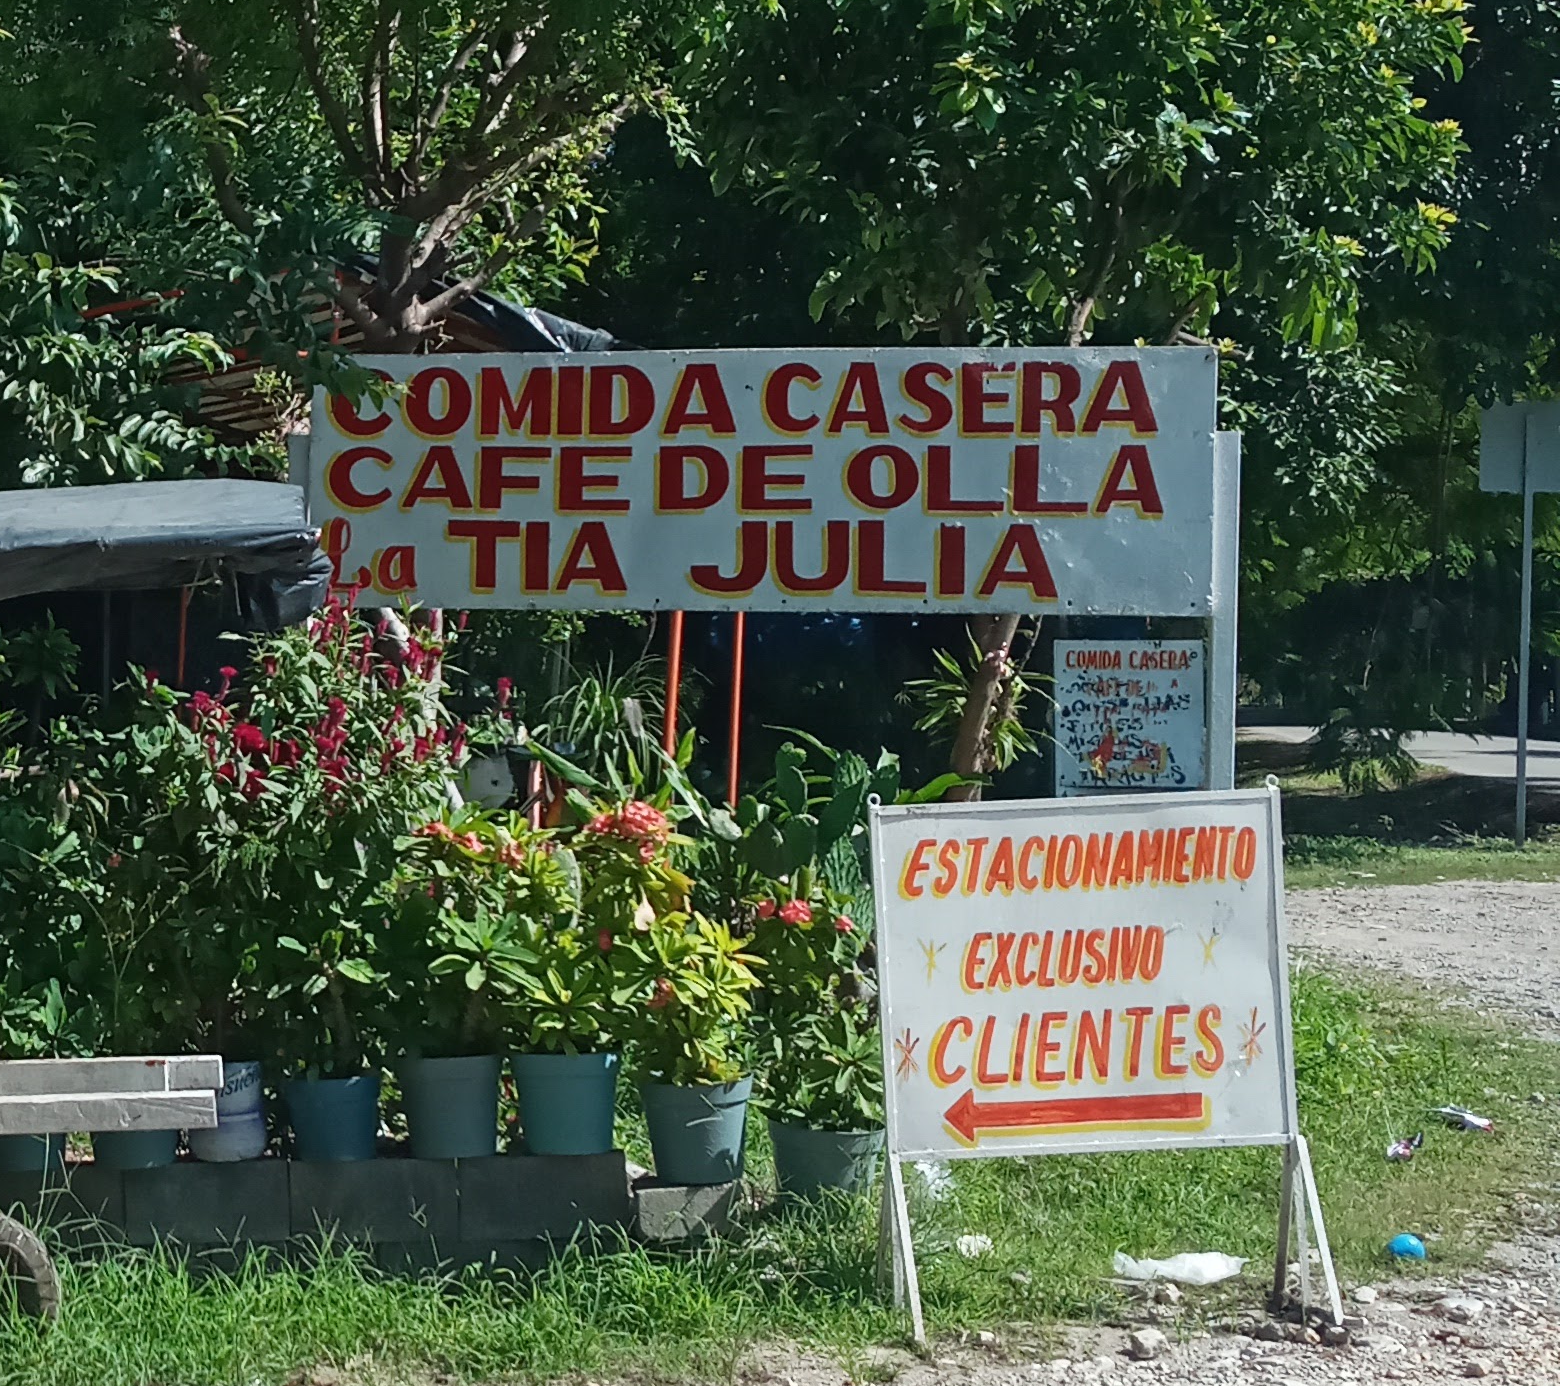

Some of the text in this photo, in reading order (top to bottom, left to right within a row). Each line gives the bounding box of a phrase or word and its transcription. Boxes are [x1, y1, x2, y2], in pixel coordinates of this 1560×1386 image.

[326, 360, 1160, 441] COMIDA CASERA
[324, 444, 1164, 517] CAFE DE OLLA
[320, 516, 1060, 599] La TIA JULIA
[1065, 649, 1122, 671] COMIDA
[899, 825, 1257, 900] ESTACIONAMIENTO
[960, 924, 1165, 991] EXCLUSIVO
[928, 1003, 1226, 1088] CLIENTES
